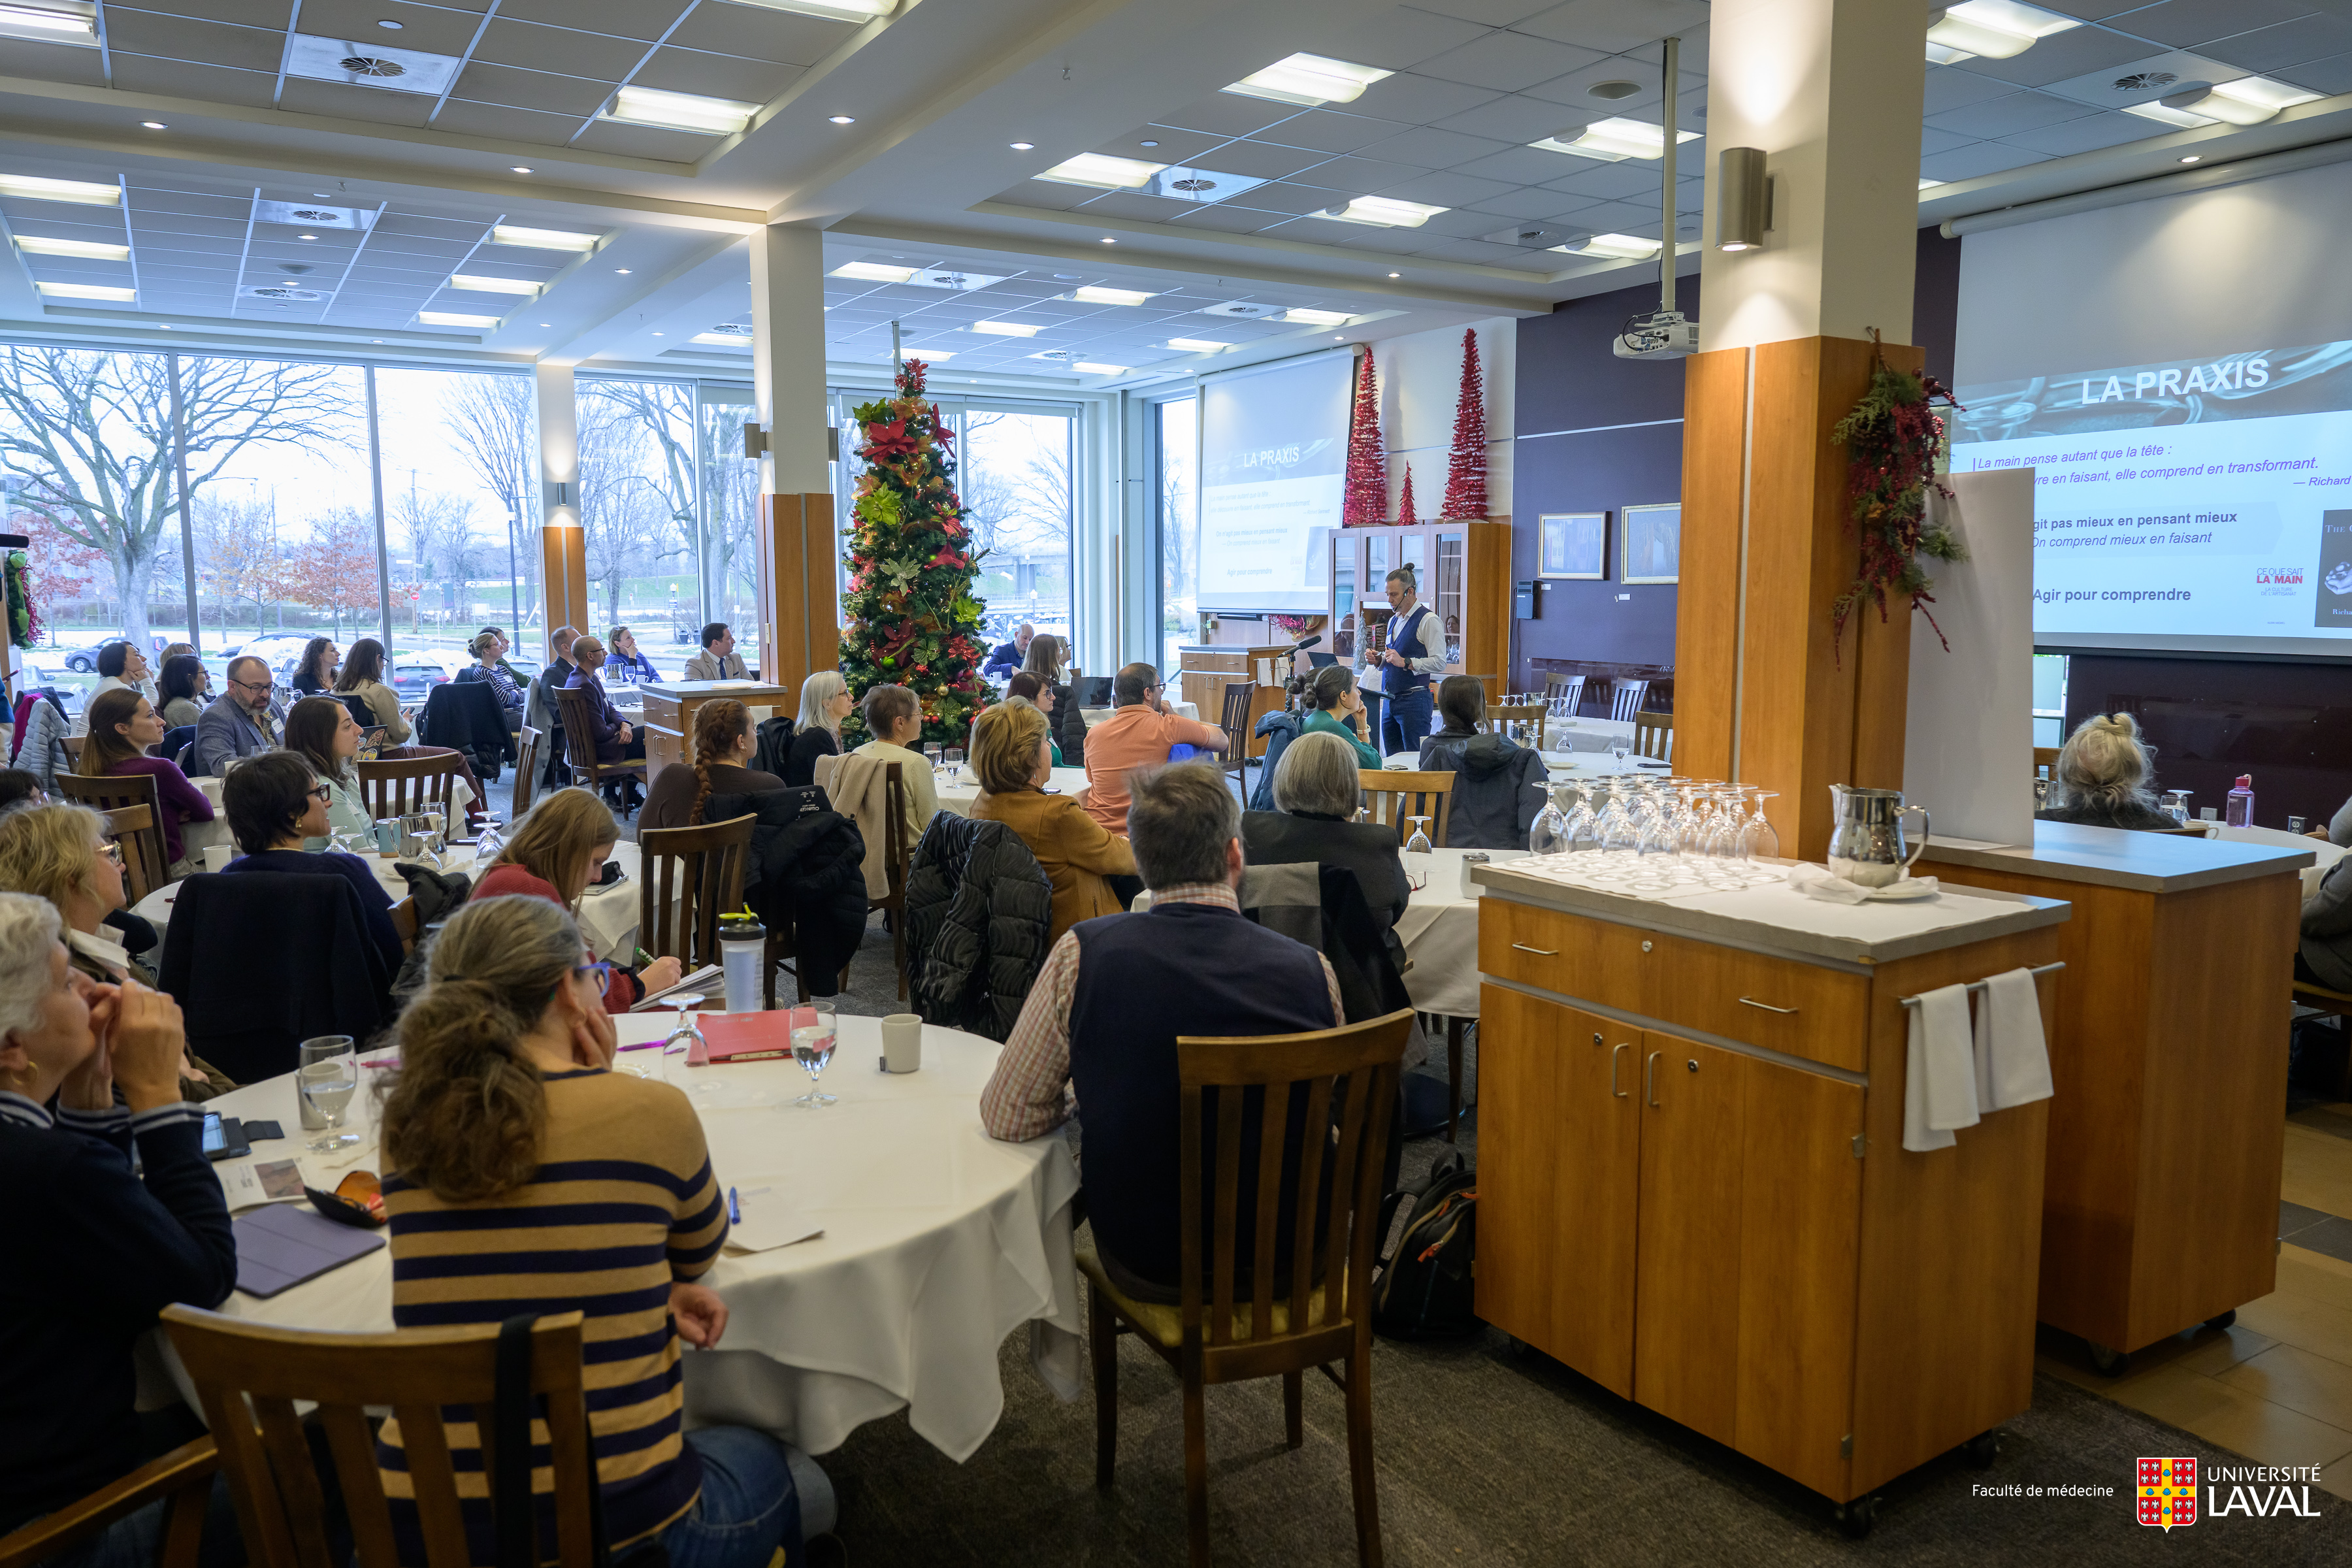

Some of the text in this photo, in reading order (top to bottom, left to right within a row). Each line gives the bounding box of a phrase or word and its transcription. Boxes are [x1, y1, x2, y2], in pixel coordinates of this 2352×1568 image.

[2082, 358, 2269, 404] LA PRAXIS
[1244, 446, 1299, 468] LA PRAXIS
[1978, 458, 1991, 468] La
[1994, 456, 2020, 467] main
[2023, 455, 2057, 468] pense
[2061, 449, 2097, 462] autant
[2100, 449, 2123, 461] que
[2126, 446, 2137, 457] la
[2141, 444, 2164, 457] tête
[2052, 474, 2066, 484] en
[2069, 470, 2111, 483] faisant,
[2115, 468, 2136, 480] elle
[2140, 463, 2204, 480] comprend
[2207, 465, 2223, 475] en
[2227, 457, 2318, 473] transformant.
[2308, 476, 2352, 486] Richard
[1261, 502, 1279, 510] comprend
[2051, 519, 2072, 531] pas
[2076, 516, 2114, 528] mieux
[2117, 516, 2132, 526] en
[2137, 513, 2191, 528] pensant
[2195, 512, 2237, 523] mieux
[2049, 534, 2107, 549] comprend
[2110, 534, 2146, 546] mieux
[2149, 534, 2165, 545] en
[2168, 531, 2212, 544] faisant
[1227, 568, 1236, 577] Agir
[1247, 567, 1272, 576] comprendre
[2268, 568, 2286, 577] QUE
[2033, 588, 2191, 604] Agir pour comprendre
